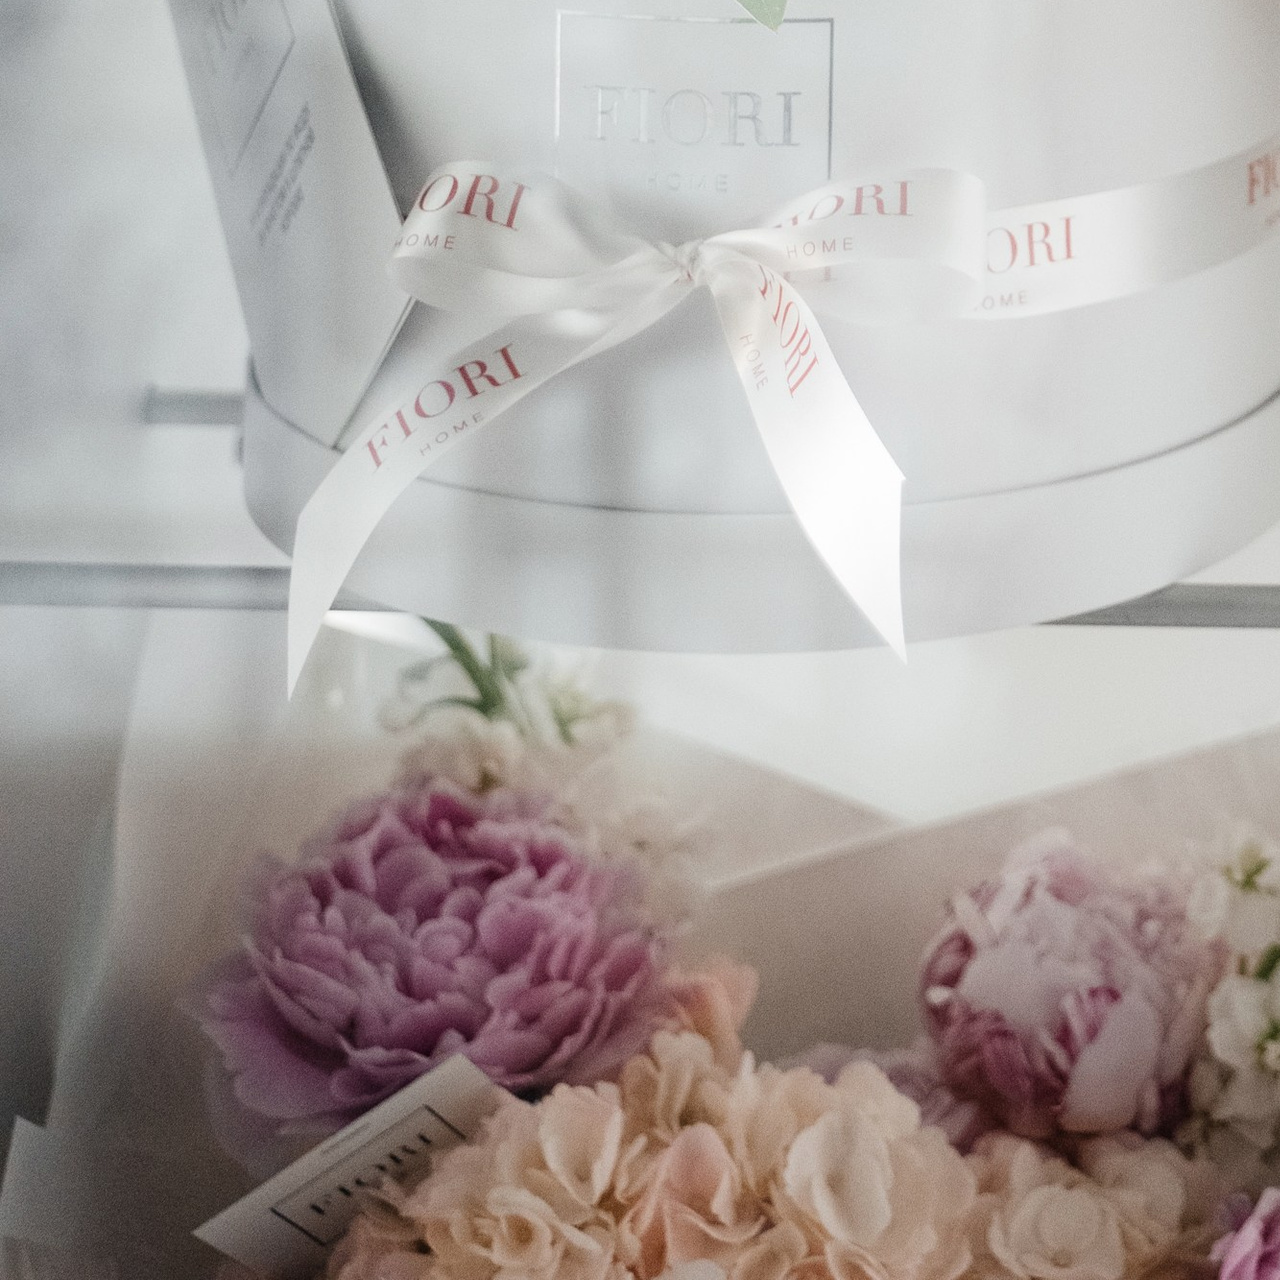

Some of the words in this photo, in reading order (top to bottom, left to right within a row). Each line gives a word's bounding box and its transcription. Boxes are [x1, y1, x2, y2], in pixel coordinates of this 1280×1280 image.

[583, 84, 802, 147] FIORI
[785, 236, 854, 259] HOME
[974, 289, 1029, 312] OME
[757, 263, 820, 399] FIORI
[739, 332, 769, 392] HOME
[362, 342, 529, 474] FIORI
[419, 412, 484, 457] HOME
